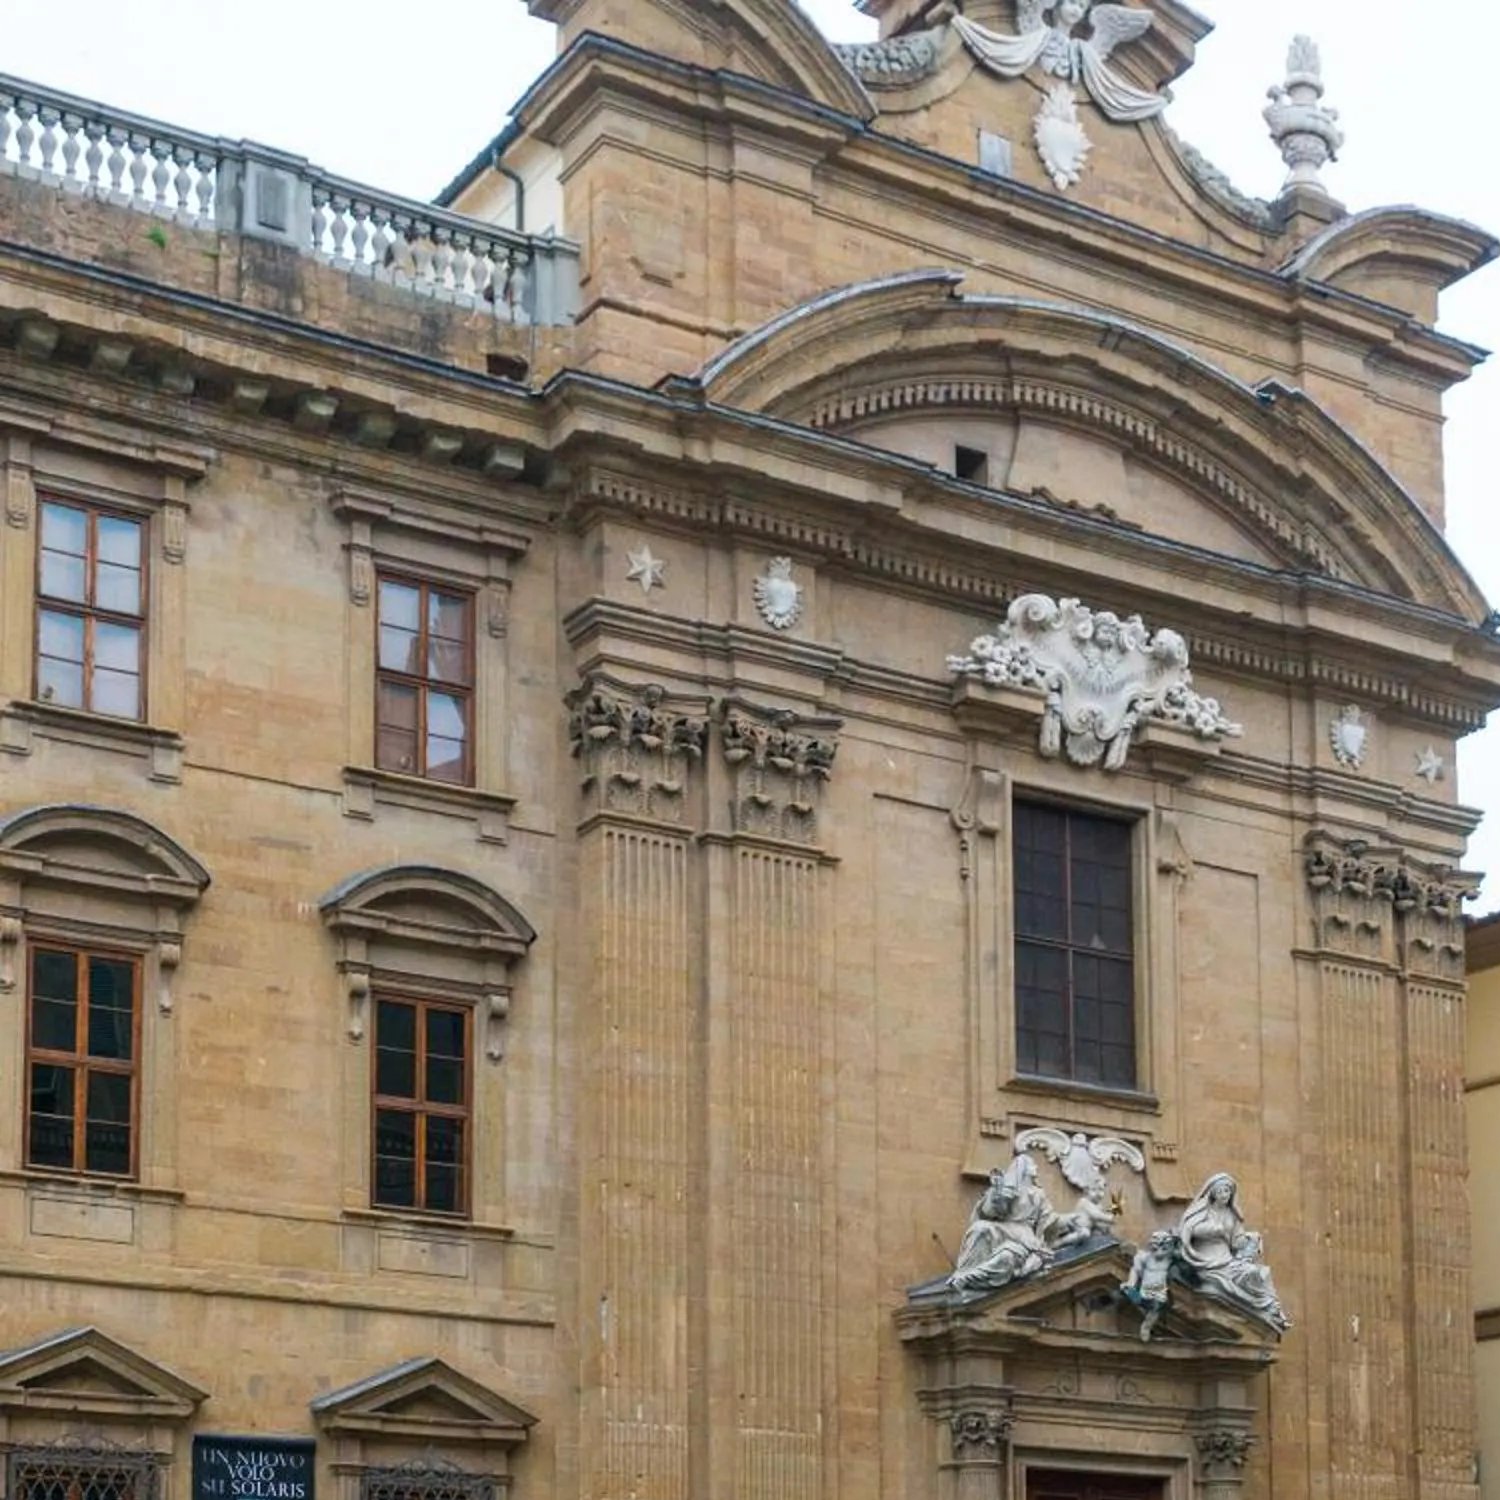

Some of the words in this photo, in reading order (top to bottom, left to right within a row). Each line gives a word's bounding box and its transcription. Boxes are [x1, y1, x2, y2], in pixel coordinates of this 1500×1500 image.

[203, 1447, 229, 1464] UN
[236, 1450, 305, 1469] NUOVO
[227, 1463, 275, 1481] VOLO
[201, 1479, 225, 1495] SU
[231, 1480, 306, 1498] SOLARIS
